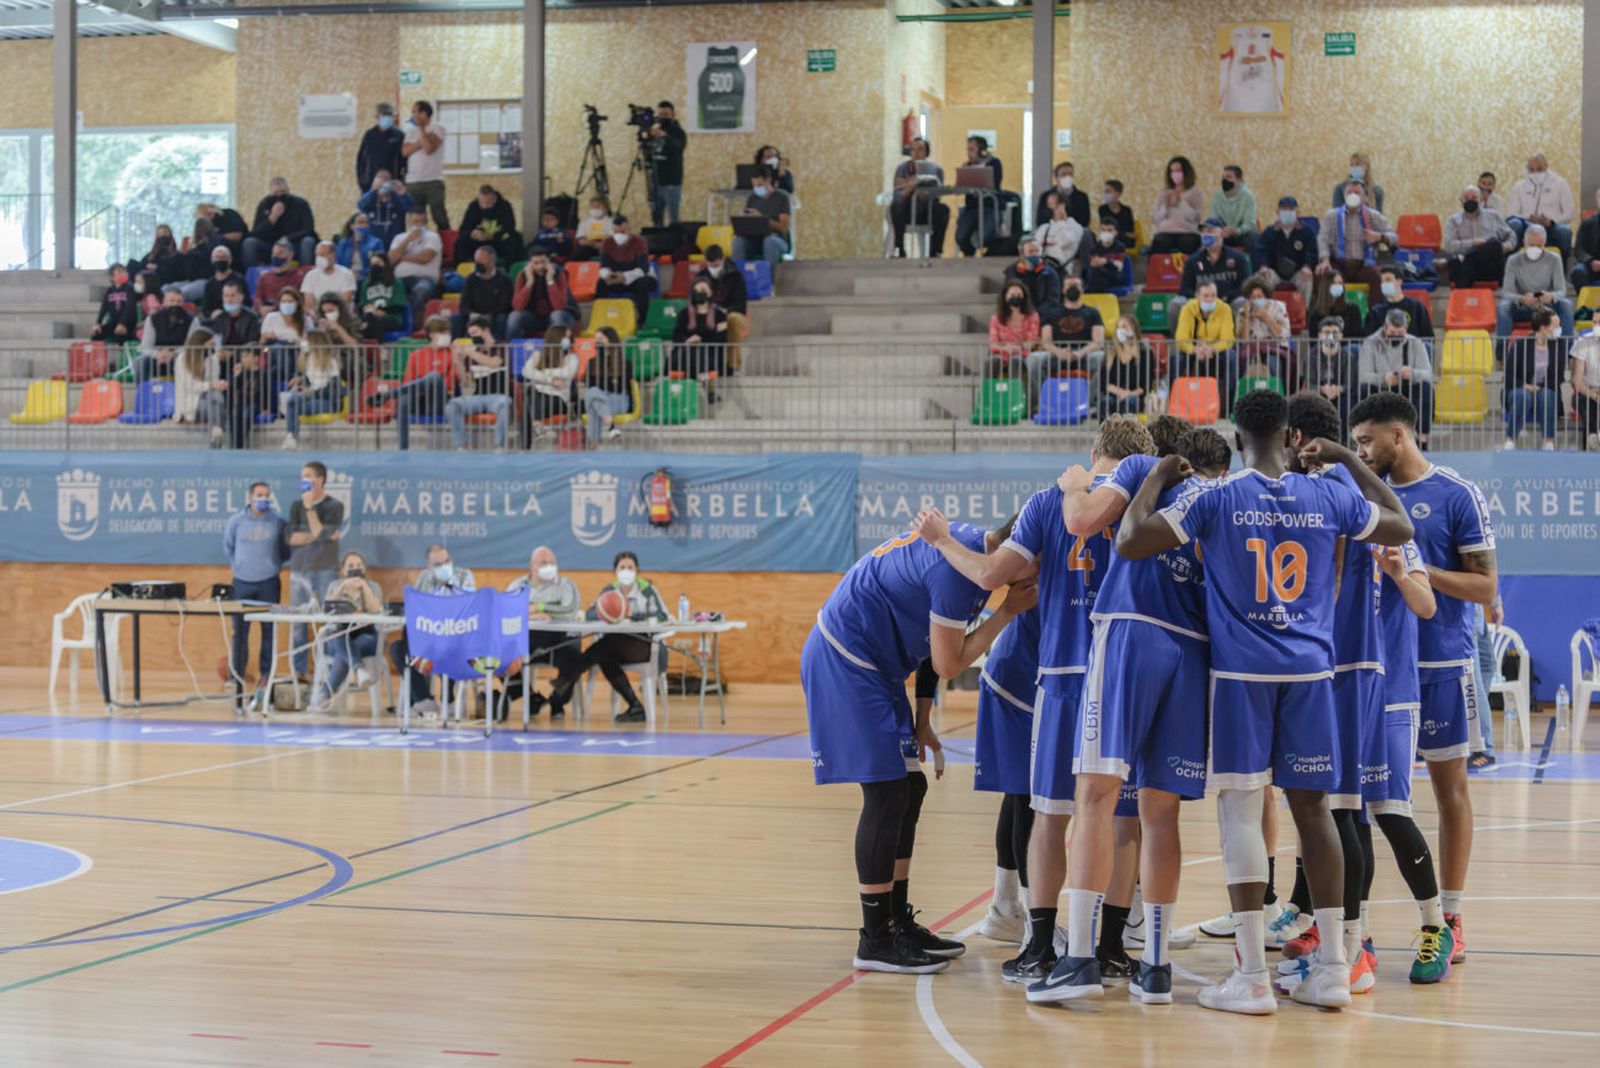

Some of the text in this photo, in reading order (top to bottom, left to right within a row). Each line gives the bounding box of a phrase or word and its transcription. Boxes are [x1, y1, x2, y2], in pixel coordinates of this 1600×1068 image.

[708, 72, 734, 93] 500
[417, 479, 522, 492] AYUNTAMIENTO
[918, 481, 1032, 494] AYUNTAMIENTO
[362, 491, 543, 517] MARBELLA
[167, 519, 179, 534] DE
[1232, 511, 1325, 529] GODSPOWER
[360, 520, 487, 538] DELEGACIÓN DE DEPORTES
[690, 523, 704, 538] DE
[708, 523, 759, 539] DEPORTES
[1520, 523, 1535, 539] DE
[1541, 523, 1598, 539] DEPORTES
[1067, 536, 1096, 587] 4
[1245, 537, 1308, 604] 10
[1247, 611, 1305, 622] MARBELLA
[415, 613, 480, 637] molten
[1297, 754, 1331, 765] Hospital
[1175, 767, 1207, 780] OCHO
[1292, 762, 1334, 774] OCHOA
